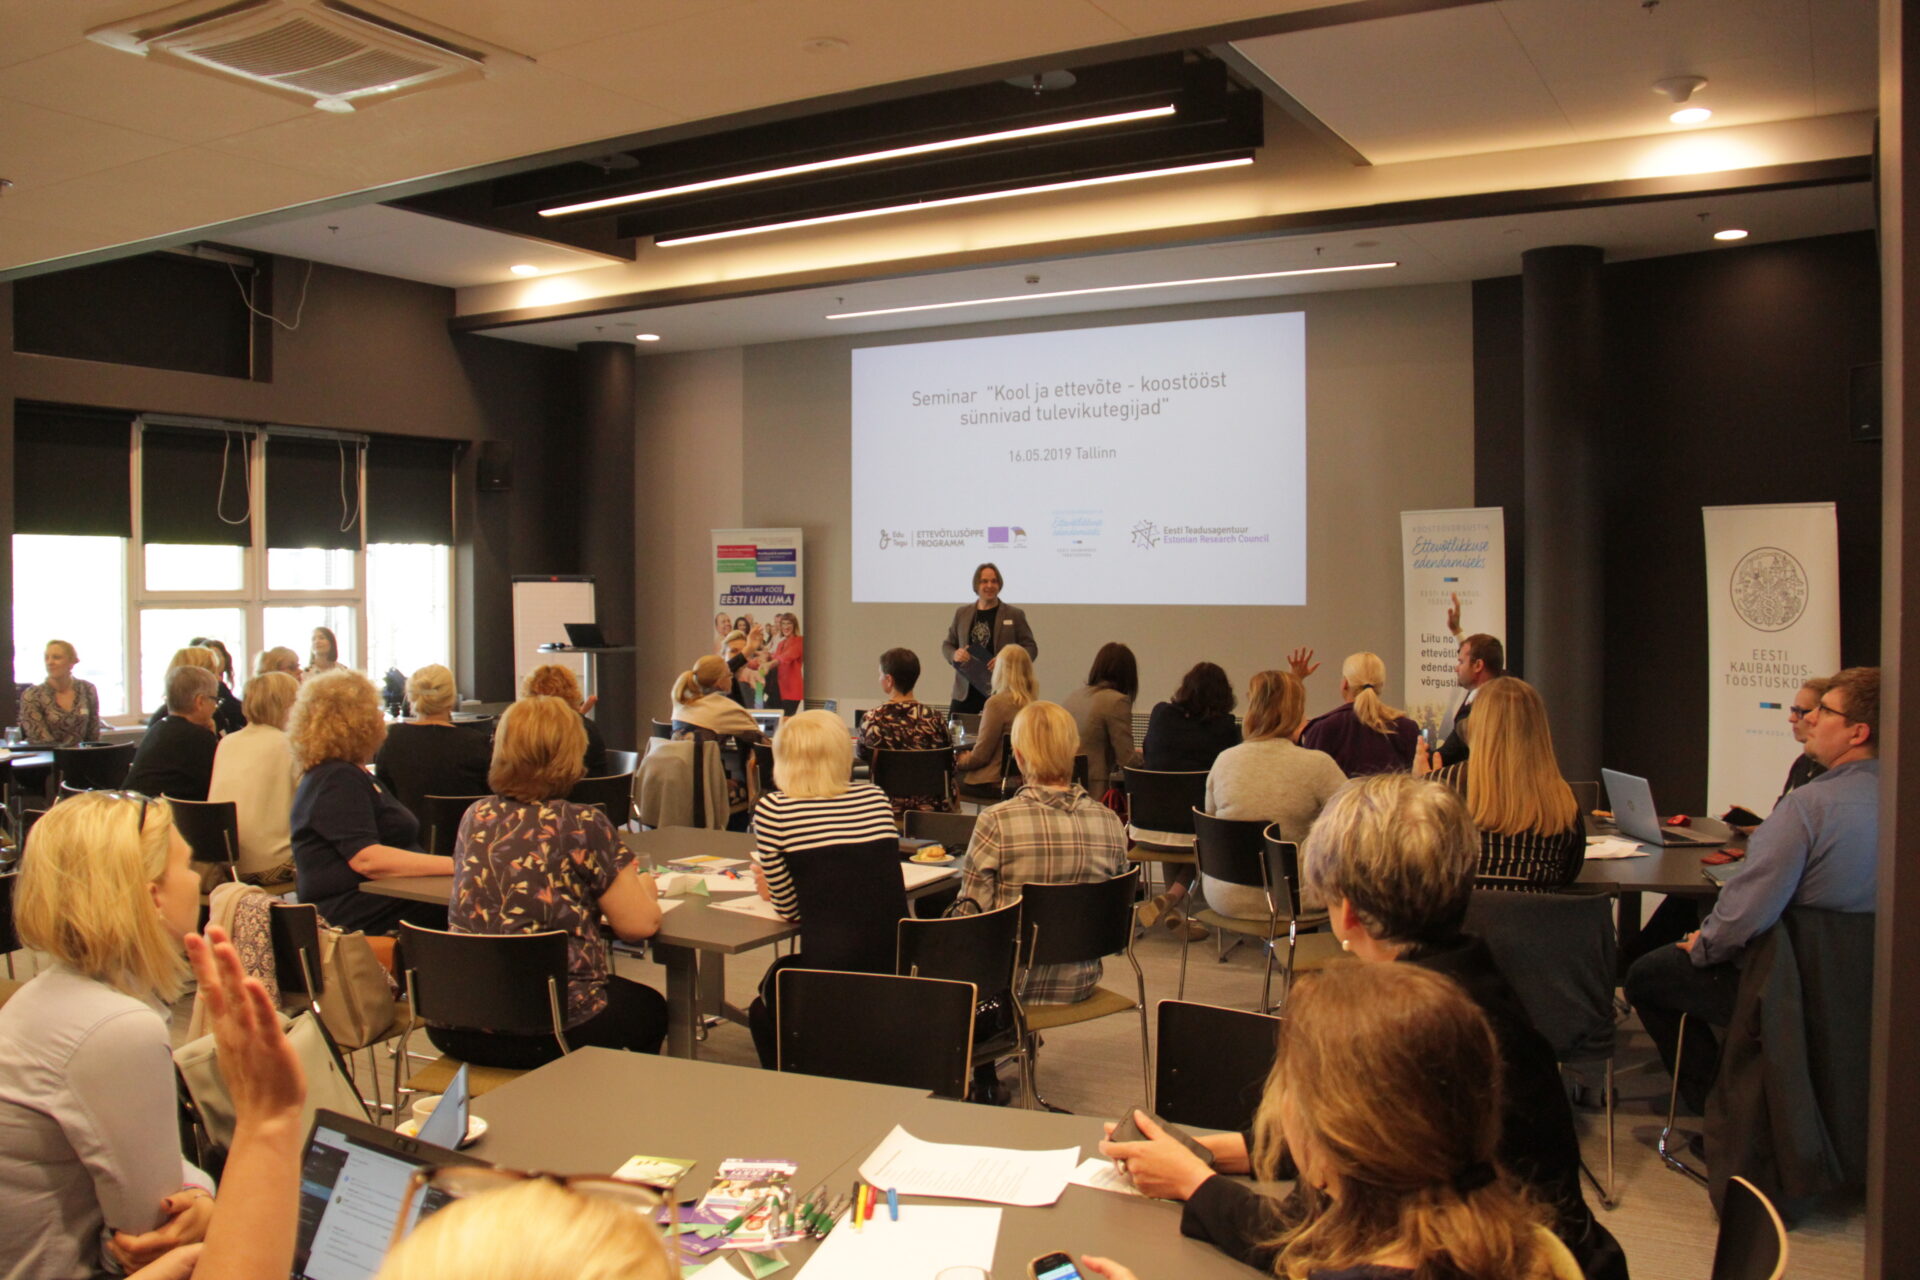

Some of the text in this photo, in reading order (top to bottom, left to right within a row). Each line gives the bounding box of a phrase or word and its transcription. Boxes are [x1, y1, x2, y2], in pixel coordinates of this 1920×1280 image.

[912, 388, 977, 407] Seminar
[987, 383, 1030, 401] "Kool
[1033, 382, 1049, 403] ja
[1054, 378, 1122, 398] ettevõte
[1140, 371, 1227, 392] koostööst
[960, 397, 1169, 425] sünnivad tulevikutegijad"
[1009, 446, 1117, 462] 16.05.2019 Tallinn
[916, 527, 985, 538] ETTEVÕTLUSÕPPE
[1163, 525, 1249, 536] Eesti Teadusagentuur
[916, 539, 965, 548] PROGRAMM
[1163, 533, 1270, 544] Estonian Research Council
[720, 595, 793, 605] EESTI LIIKUMA
[1421, 633, 1441, 643] Liitu
[1421, 648, 1458, 658] ettevõtli
[1752, 649, 1788, 661] EESTI
[1730, 661, 1813, 676] KAUBANDUS-
